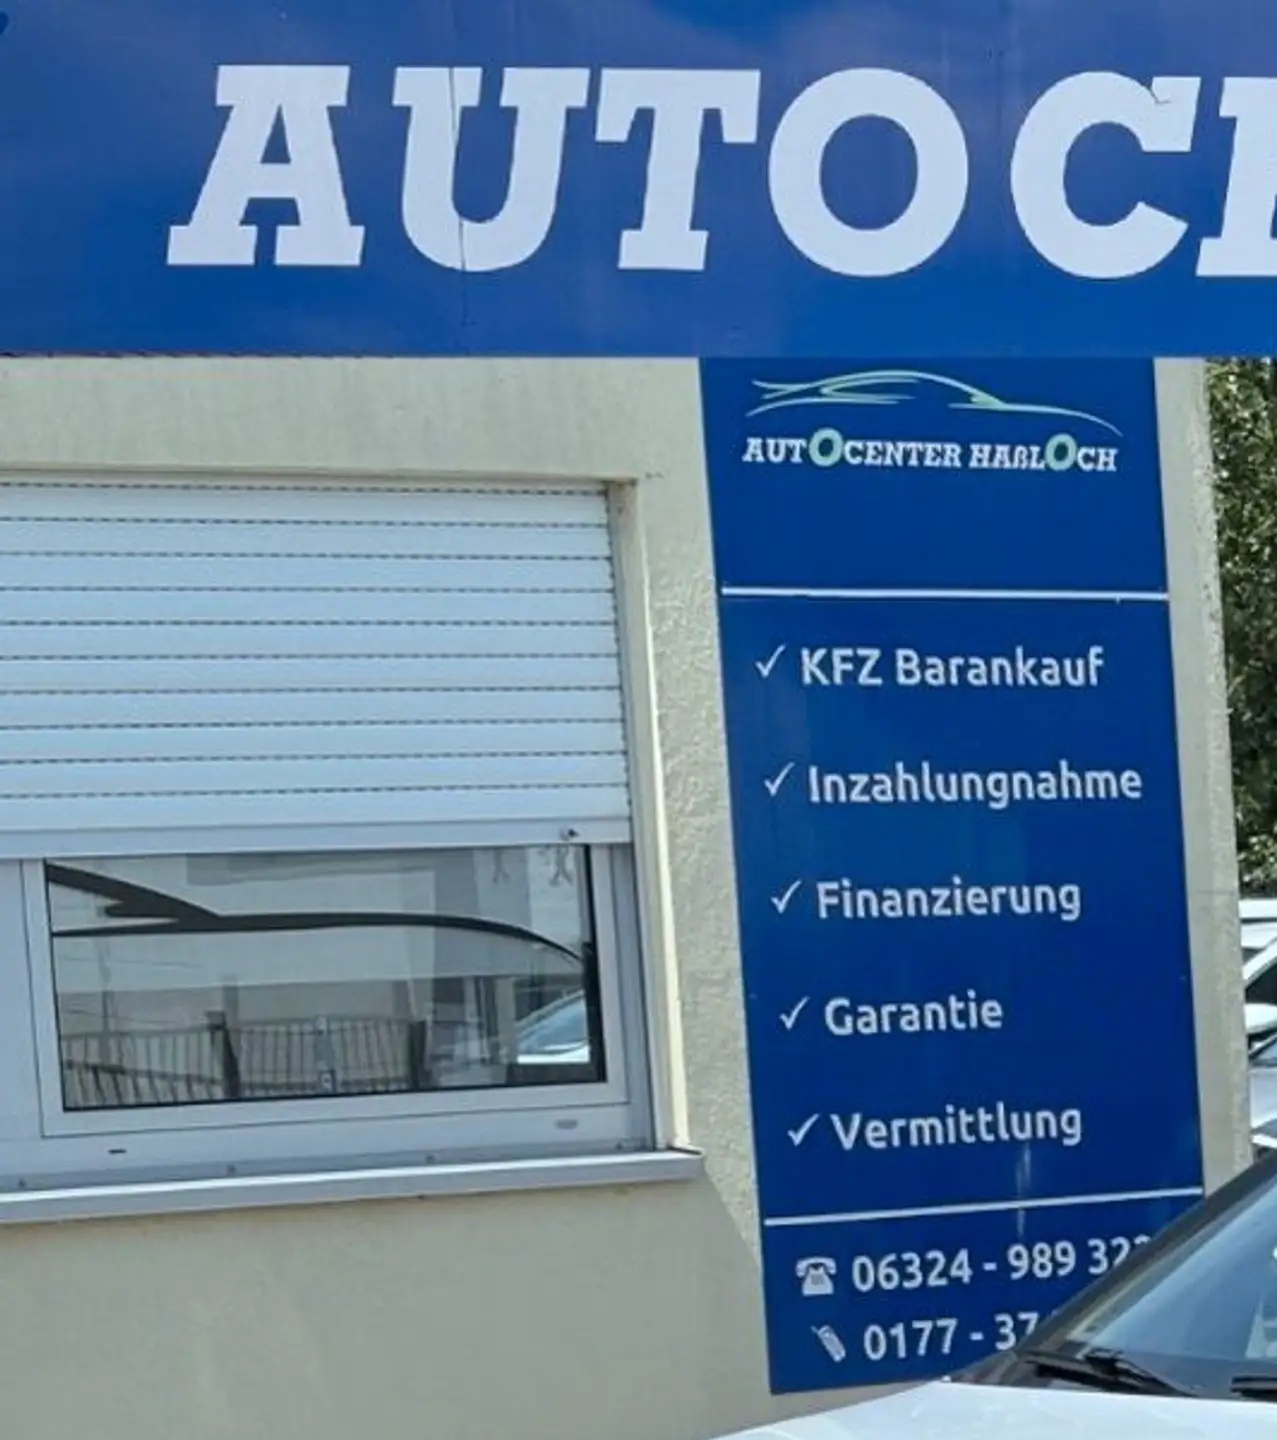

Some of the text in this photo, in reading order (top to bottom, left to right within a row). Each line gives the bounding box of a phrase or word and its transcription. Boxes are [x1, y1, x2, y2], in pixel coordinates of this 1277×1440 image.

[742, 429, 1118, 472] AUTOCENTER HAßLOCH
[801, 645, 1104, 687] KFZ Barankauf
[809, 759, 1142, 810] Inzahlungnahme
[816, 875, 1081, 921] Finanzierung
[825, 989, 1003, 1036] Garantie
[830, 1101, 1082, 1150] Vermittlung
[852, 1248, 973, 1292] 06324
[1007, 1240, 1076, 1281] 989
[1087, 1234, 1152, 1275] 32
[863, 1318, 958, 1361] 0177
